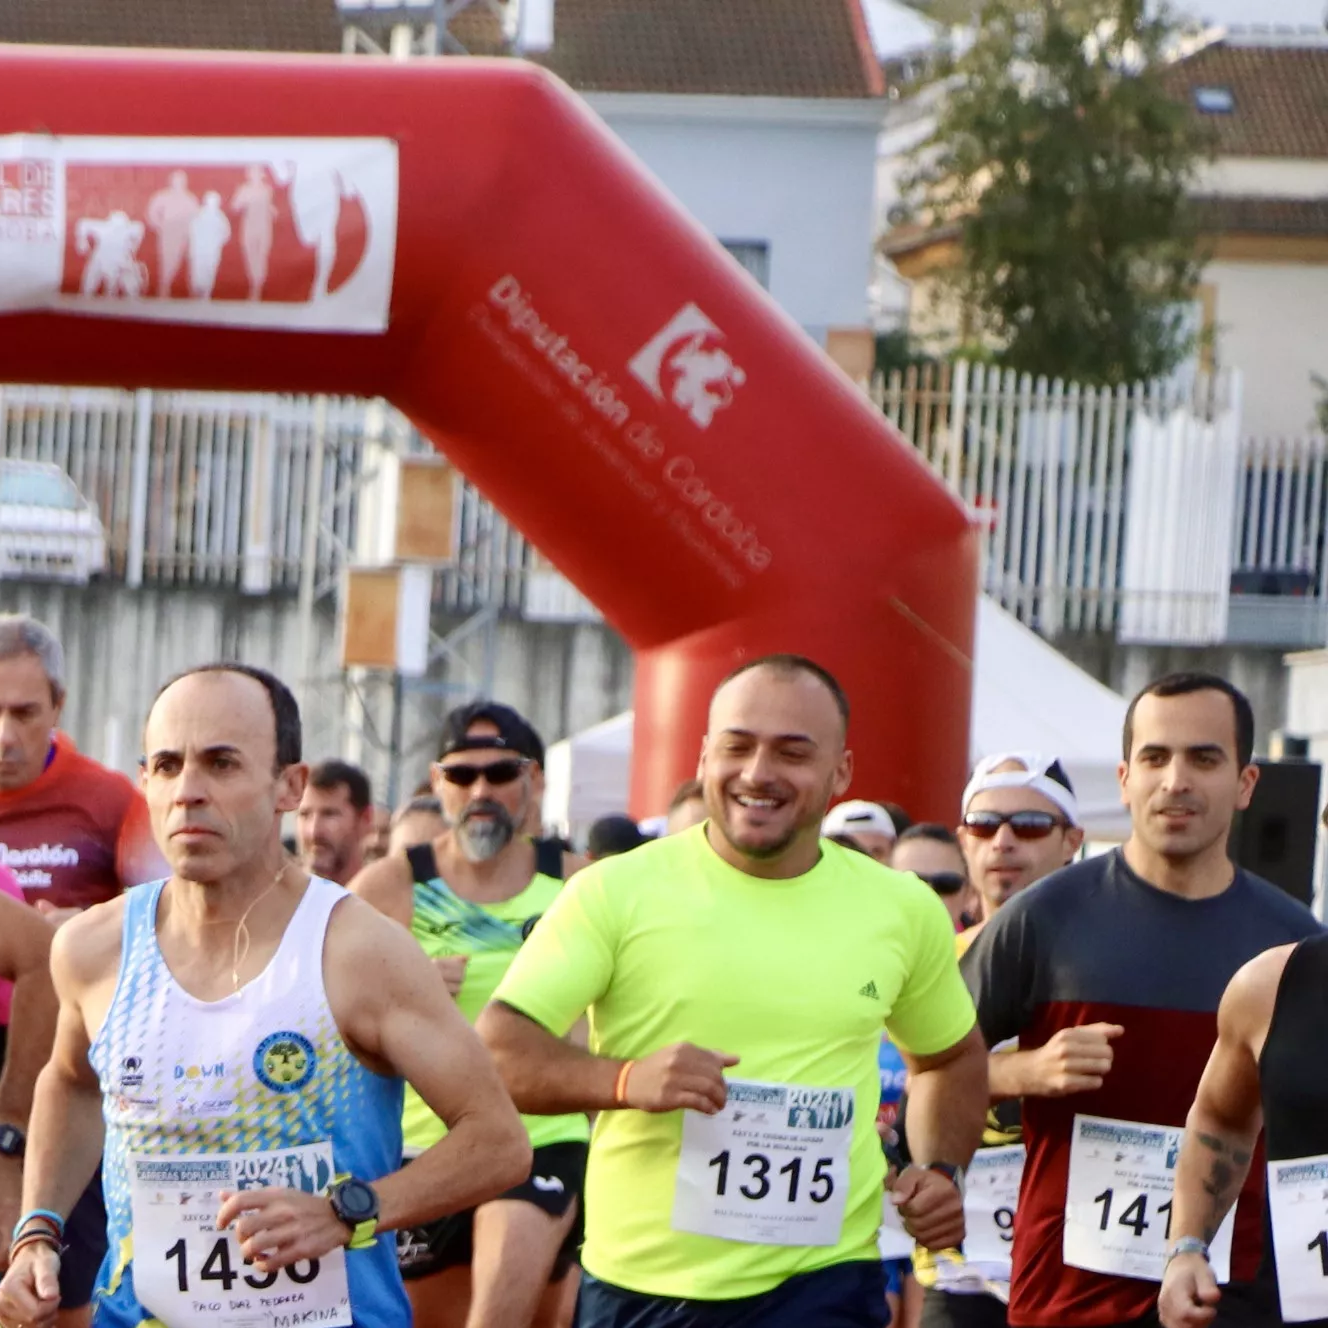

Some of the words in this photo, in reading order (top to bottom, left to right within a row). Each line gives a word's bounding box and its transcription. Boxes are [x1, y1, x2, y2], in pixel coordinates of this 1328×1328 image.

[23, 161, 56, 186] DE
[234, 1155, 287, 1180] 2024
[708, 1150, 834, 1203] 1315
[994, 1206, 1015, 1241] 9
